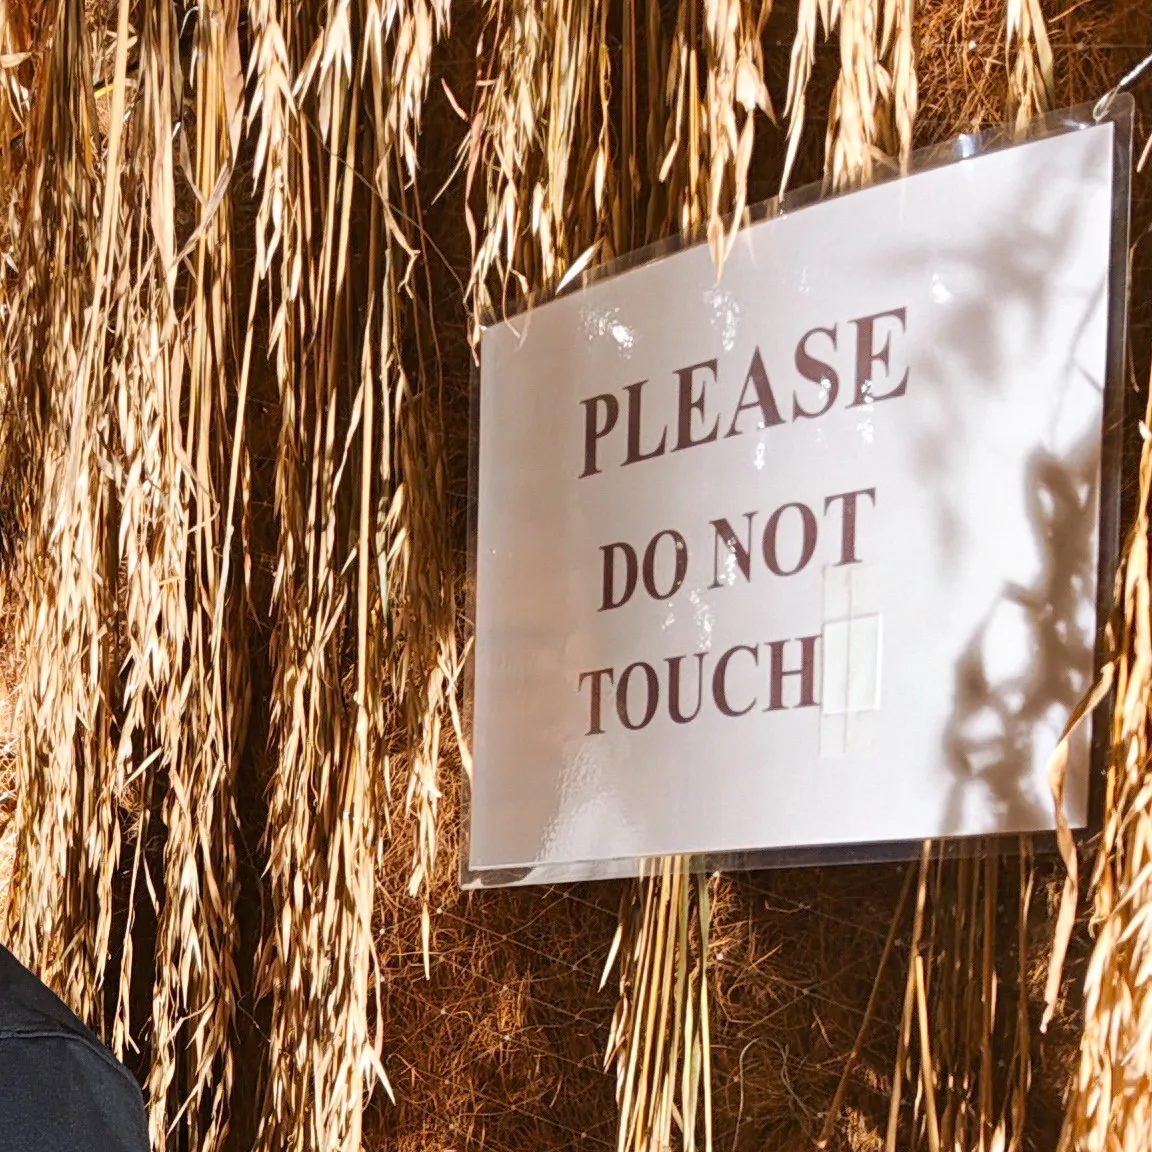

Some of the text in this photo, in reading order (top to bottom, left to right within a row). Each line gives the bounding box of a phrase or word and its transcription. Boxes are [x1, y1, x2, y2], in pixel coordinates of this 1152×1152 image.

[578, 306, 911, 479] PLEASE
[597, 487, 876, 613] DO NOT
[578, 634, 822, 737] TOUCH
